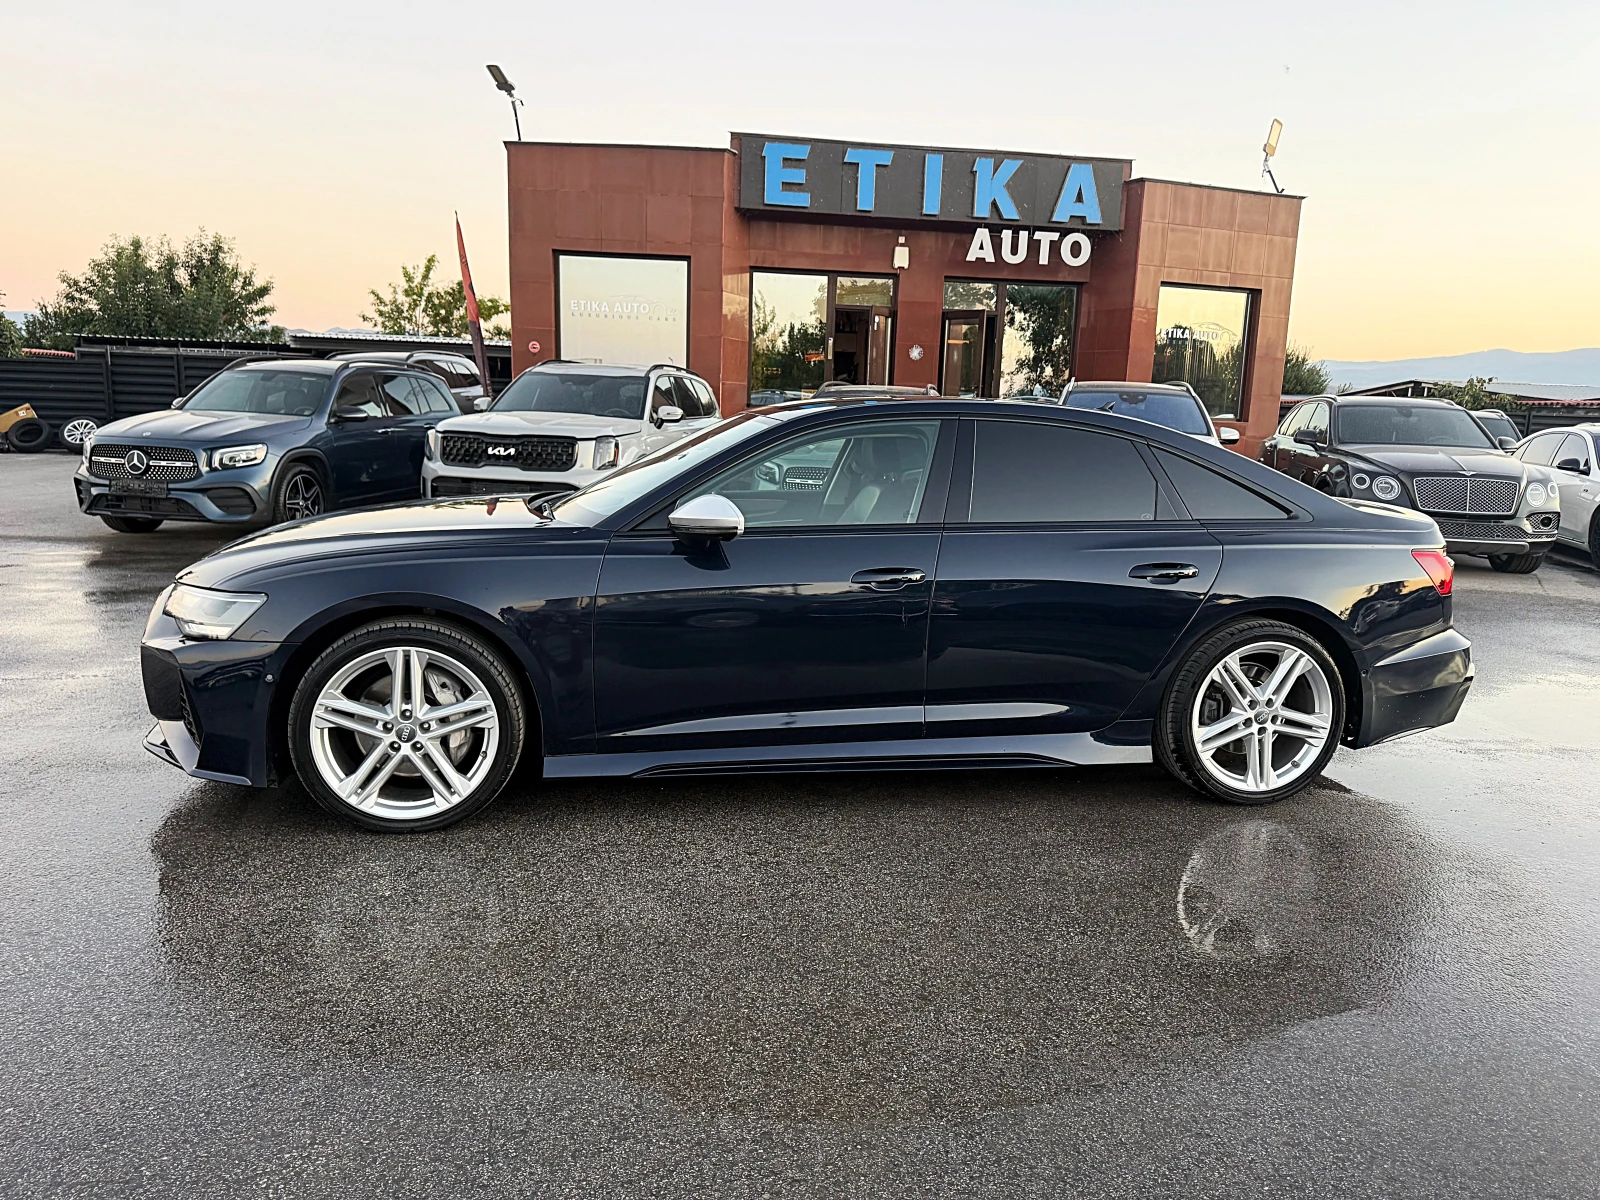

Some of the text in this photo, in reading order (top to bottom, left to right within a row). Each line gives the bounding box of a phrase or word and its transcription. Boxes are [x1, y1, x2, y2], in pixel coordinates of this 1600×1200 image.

[762, 141, 1103, 224] ETIKA
[965, 227, 1092, 267] AUTO
[570, 300, 649, 314] ETIKA AUTO
[571, 312, 640, 320] LUXURIOUS
[1160, 328, 1220, 340] ETIKA AUTO
[487, 446, 516, 456] KIA
